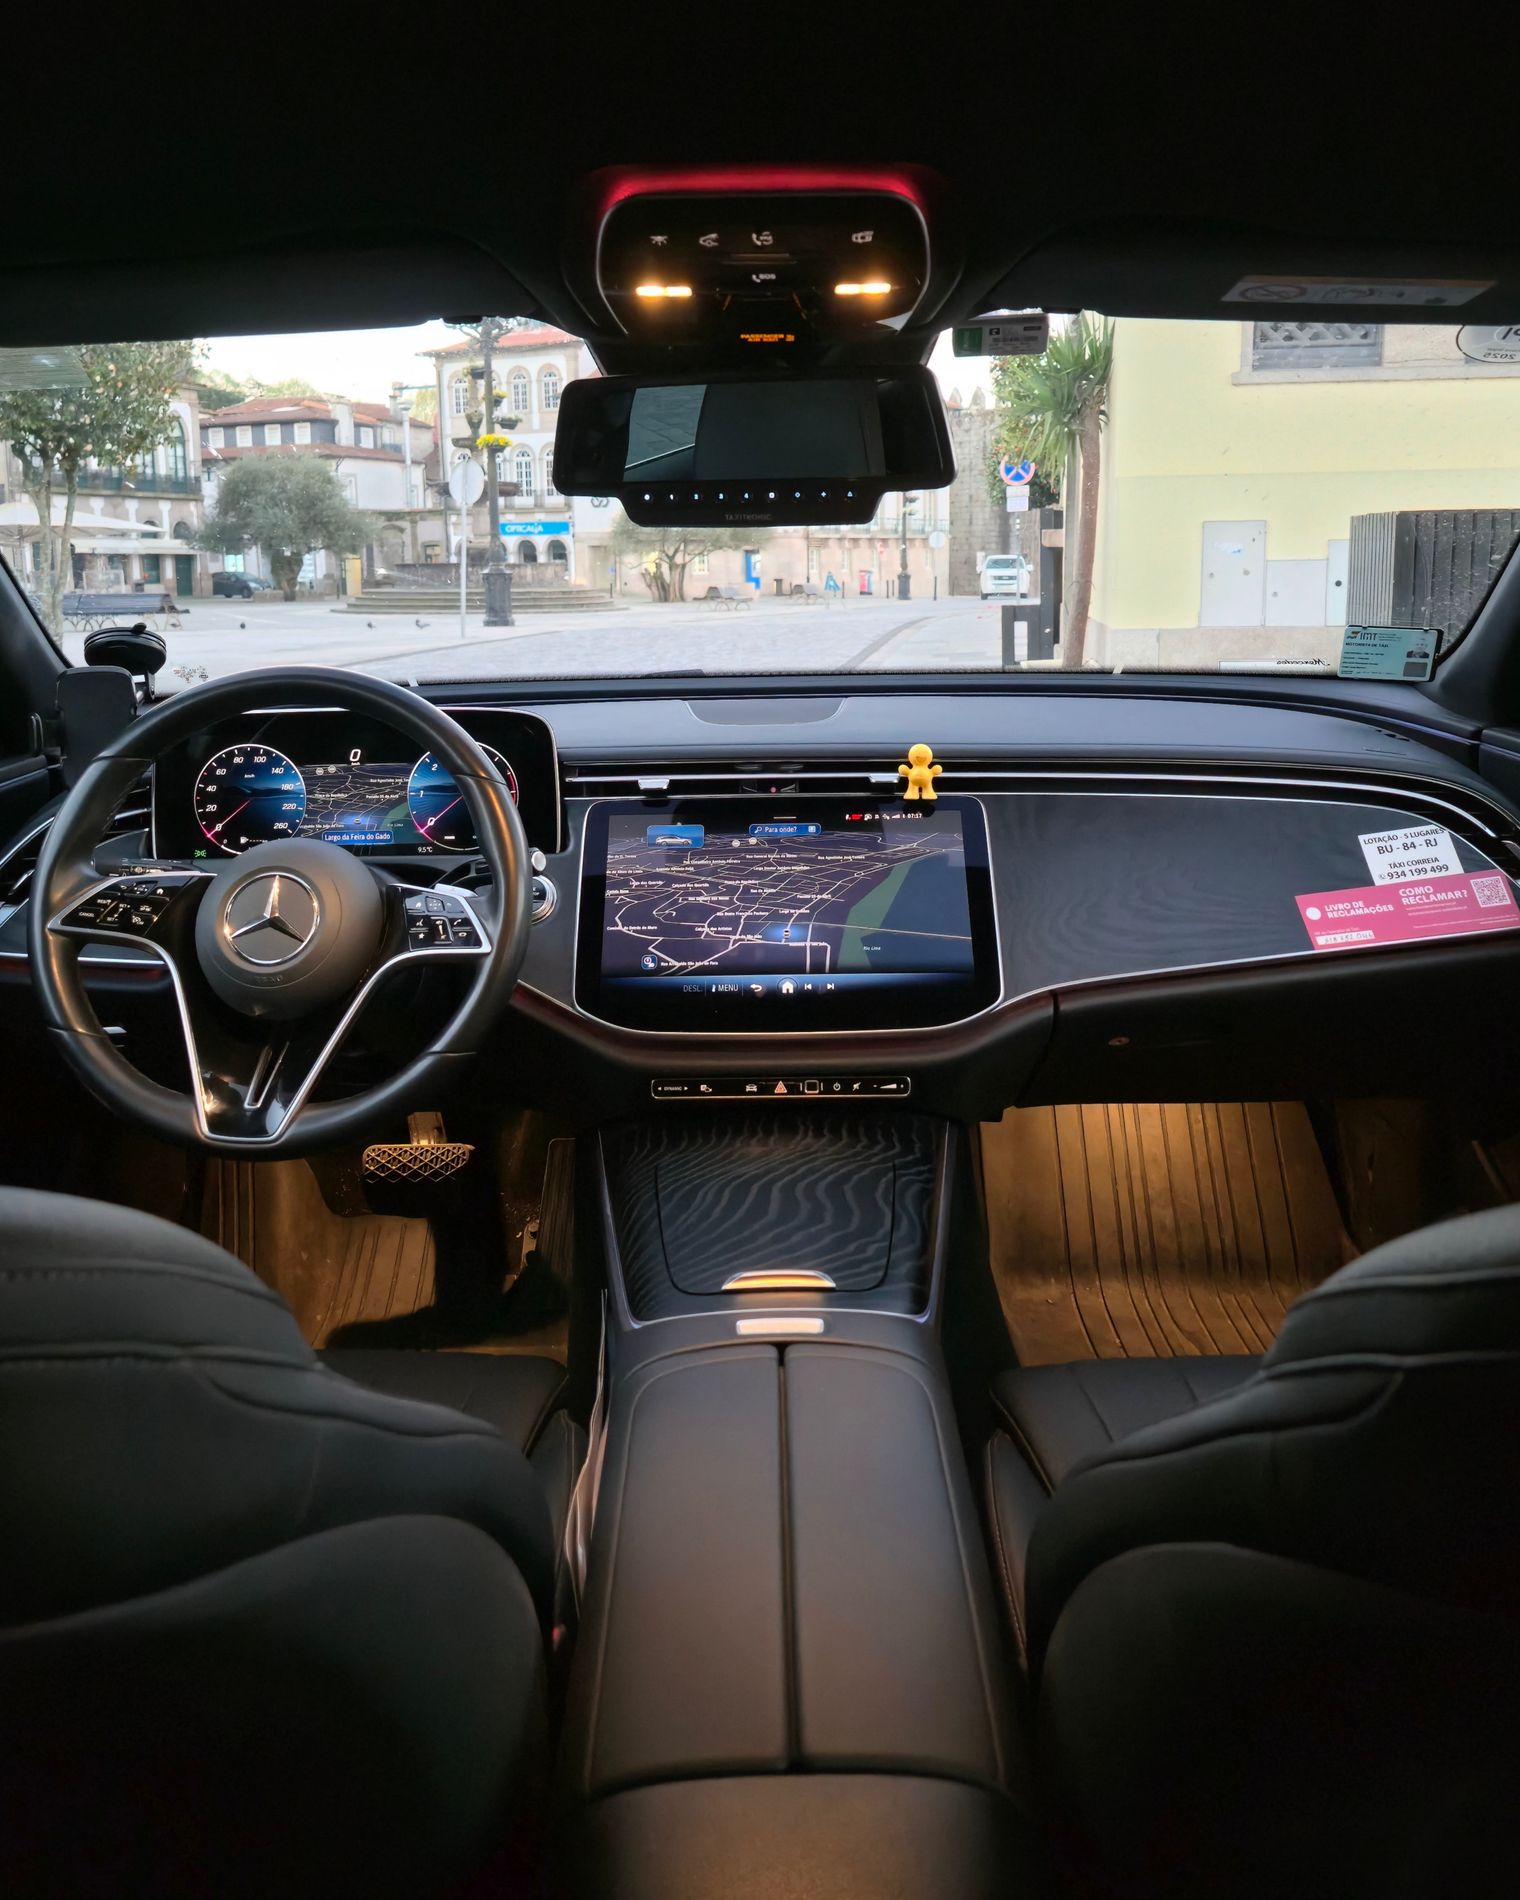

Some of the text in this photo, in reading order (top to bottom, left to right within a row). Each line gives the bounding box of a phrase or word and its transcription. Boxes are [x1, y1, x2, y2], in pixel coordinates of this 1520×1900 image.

[350, 749, 361, 762] 0
[428, 817, 435, 826] 0
[1363, 834, 1398, 845] LOTAÇÃO
[1410, 828, 1445, 838] LUGARES
[1377, 844, 1394, 854] BU
[1402, 842, 1416, 851] 84
[1424, 838, 1438, 847] RJ
[1407, 857, 1440, 866] CORREIA
[1387, 864, 1449, 879] 934 199 499
[1399, 886, 1433, 896] COMO
[1402, 890, 1468, 905] RECLAMAR?
[1324, 903, 1350, 912] LIVRO
